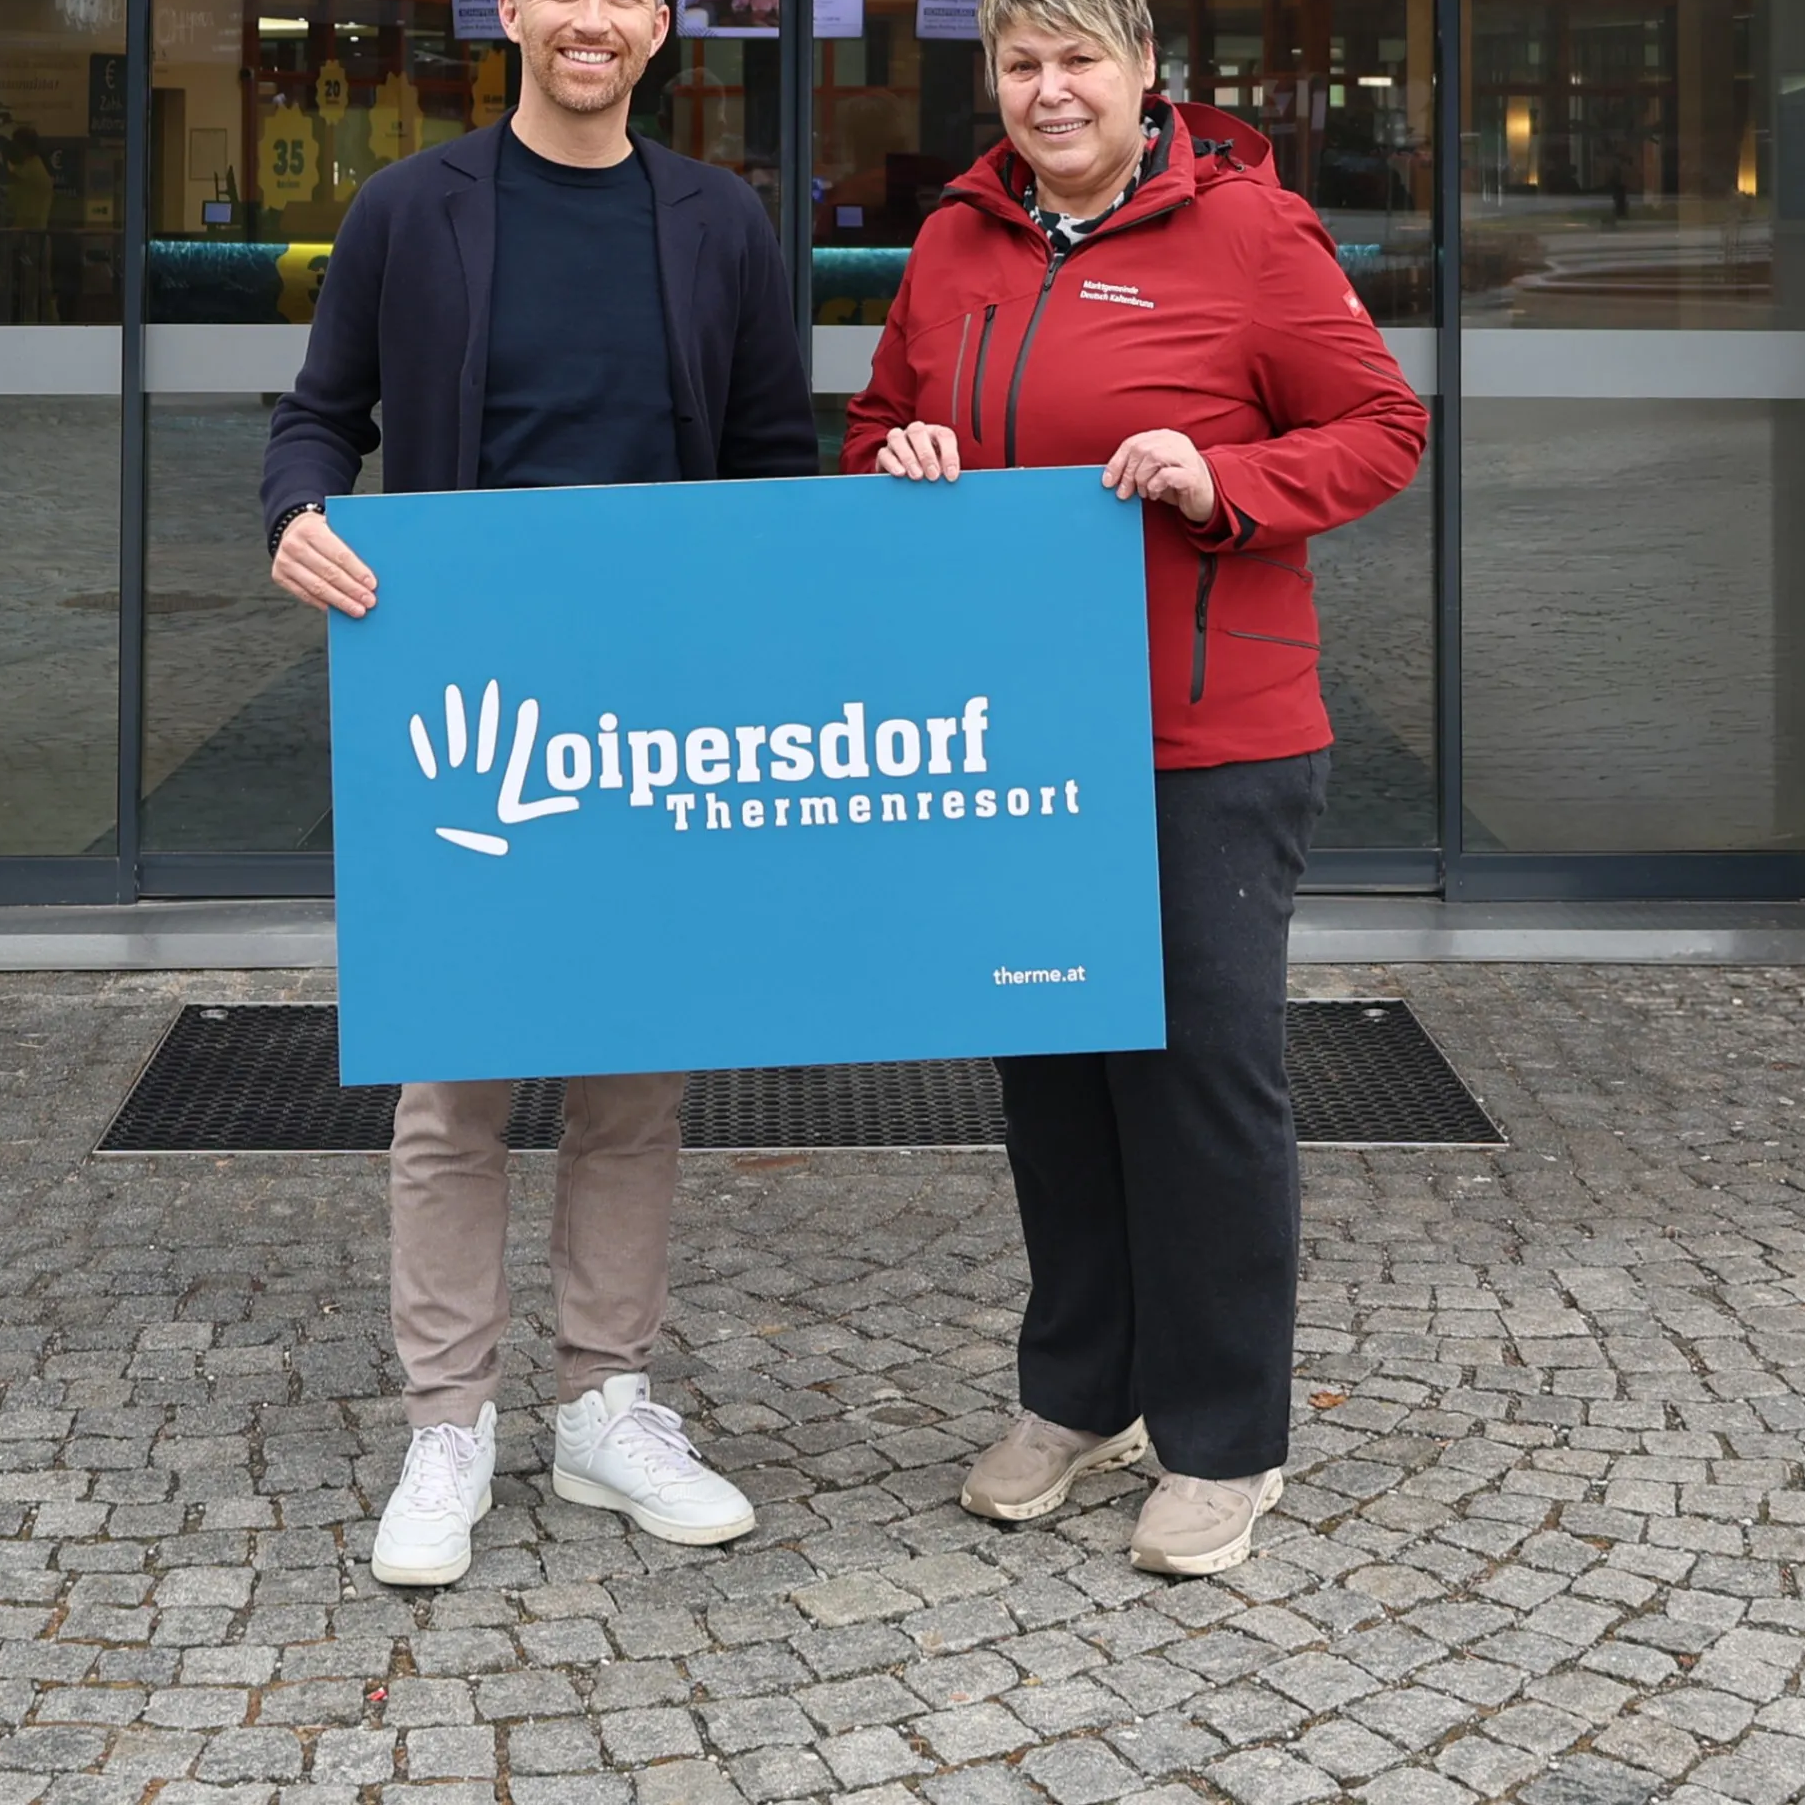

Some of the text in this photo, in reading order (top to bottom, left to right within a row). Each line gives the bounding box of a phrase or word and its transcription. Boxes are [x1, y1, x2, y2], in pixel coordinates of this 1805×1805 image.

[324, 79, 341, 97] 20
[272, 138, 306, 176] 35
[497, 696, 990, 825] Loipersdorf
[666, 778, 1081, 832] Thermenresort
[991, 964, 1087, 987] therme.at
